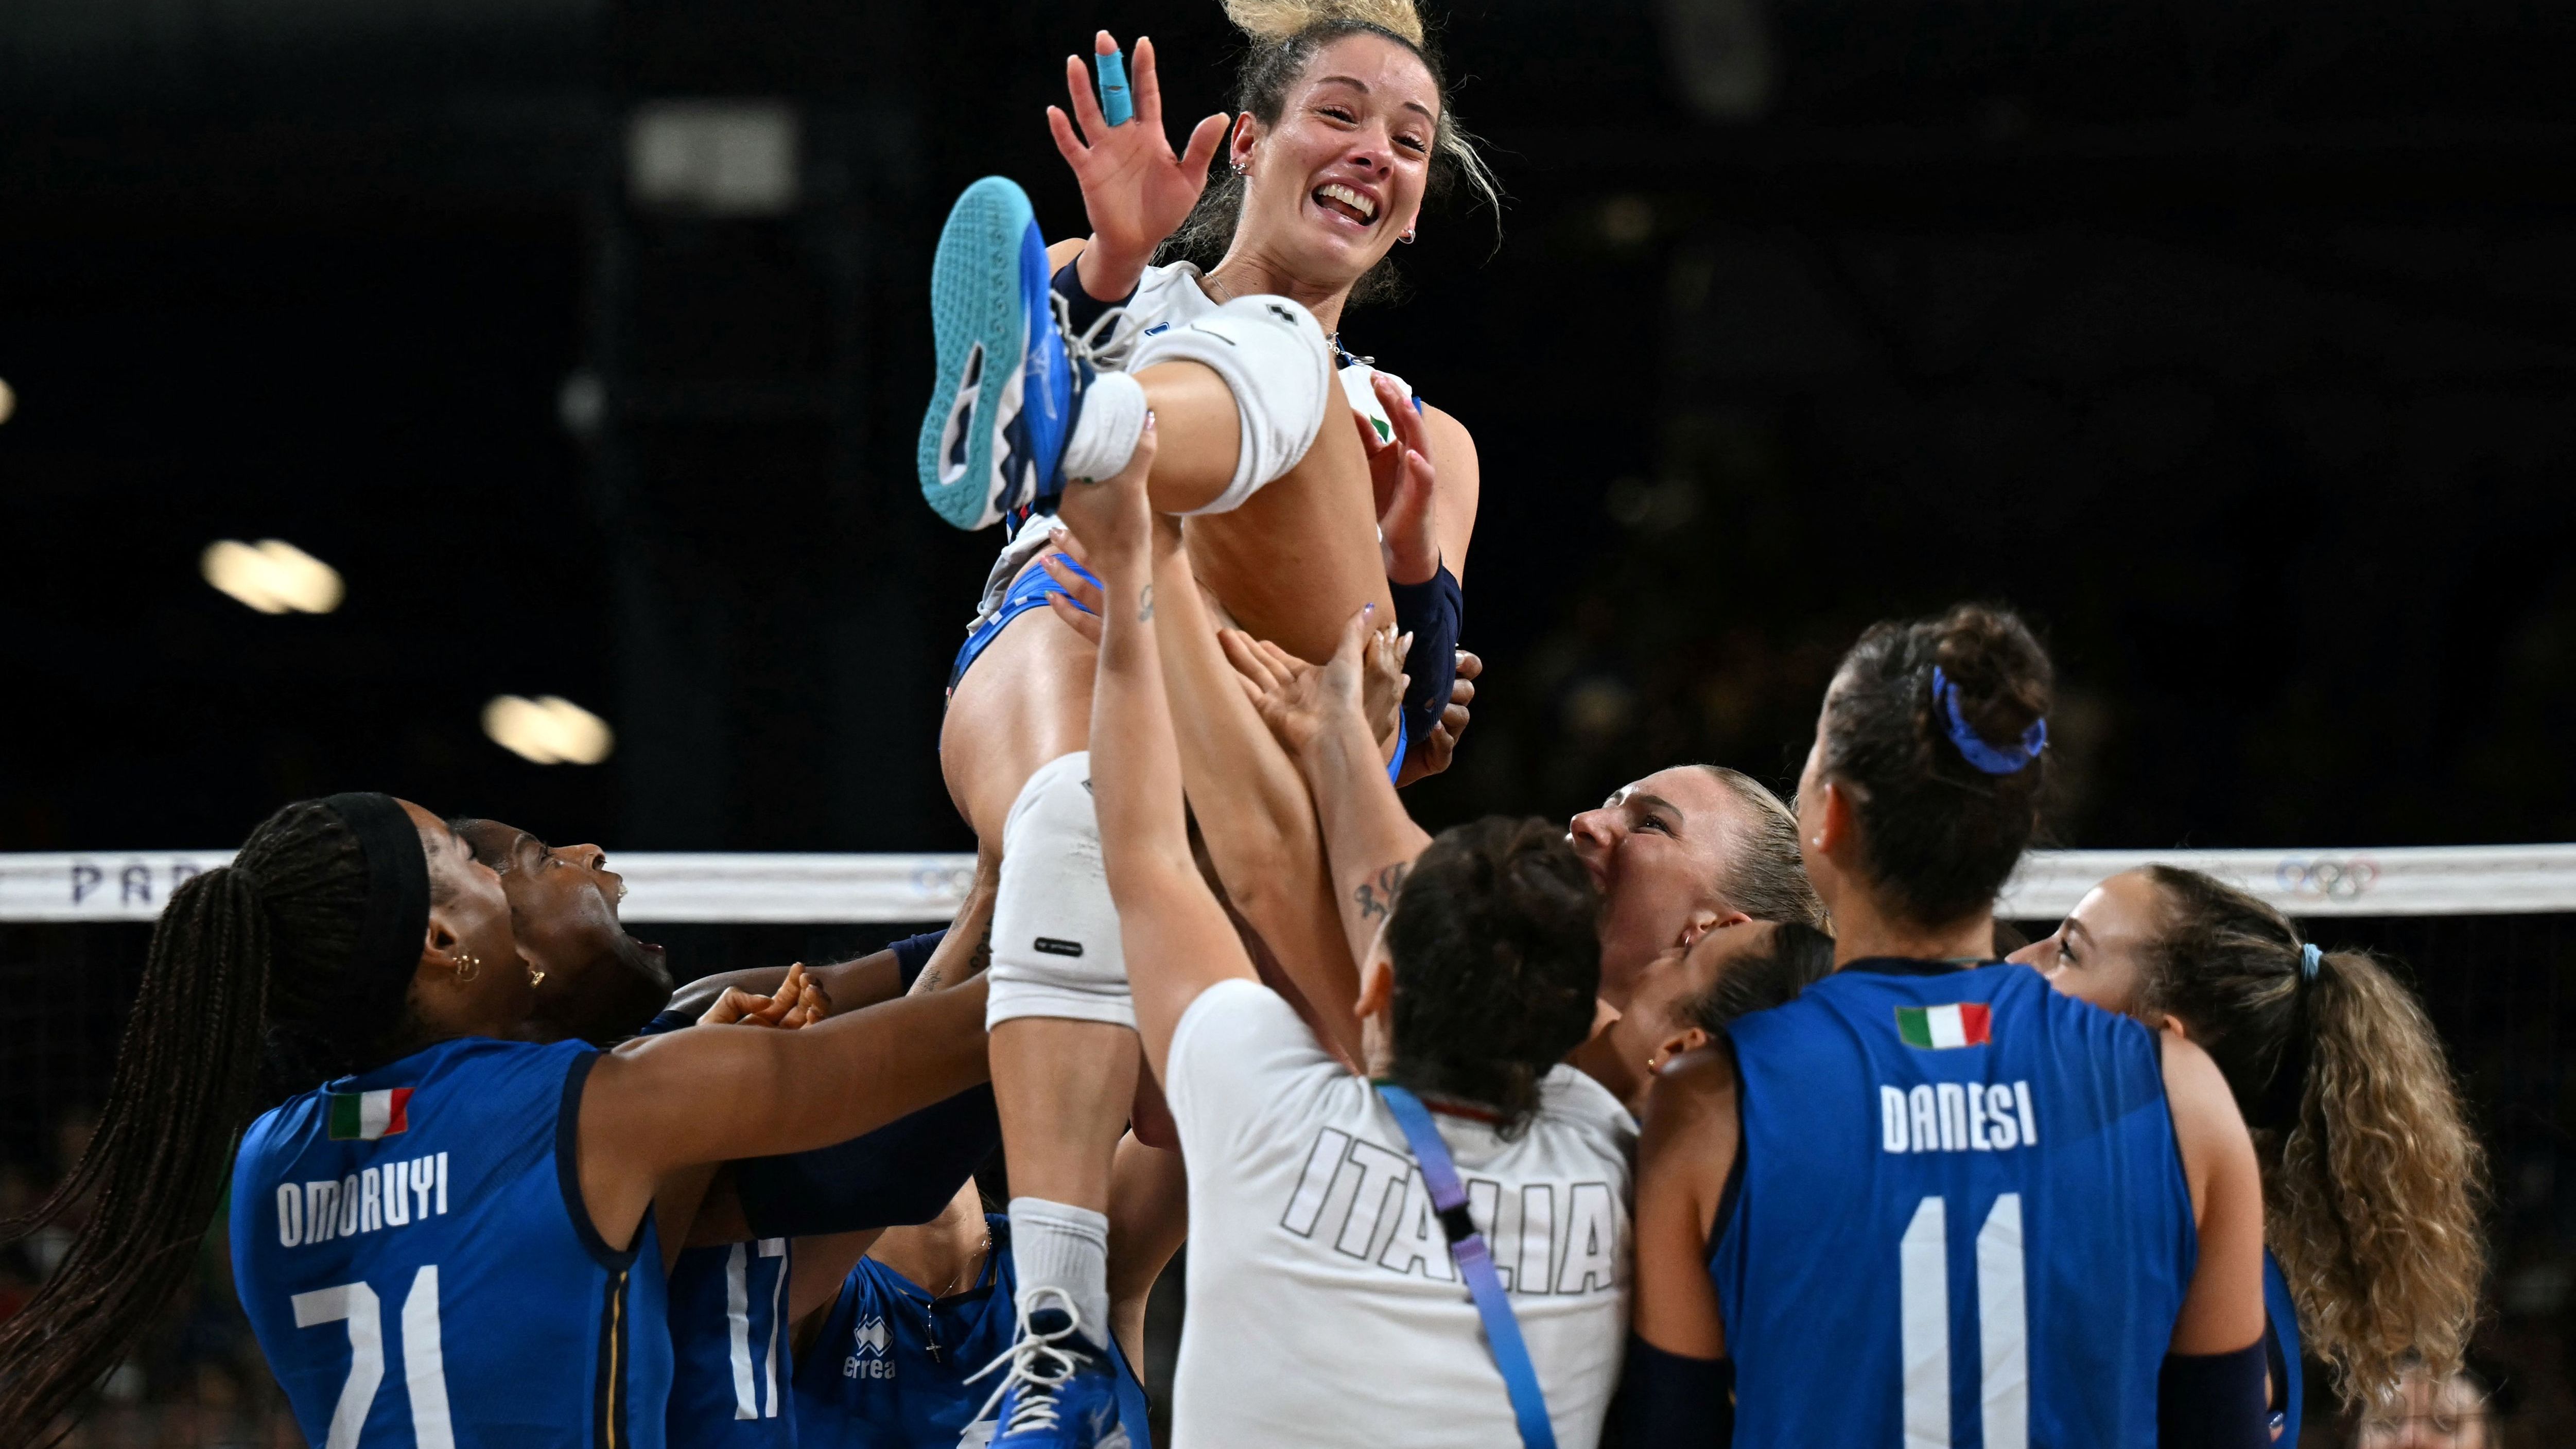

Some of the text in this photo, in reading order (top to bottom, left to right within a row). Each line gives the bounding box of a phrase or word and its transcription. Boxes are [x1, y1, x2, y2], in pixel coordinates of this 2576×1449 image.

[1880, 1081, 2037, 1153] DANESI
[276, 1151, 448, 1248] OMORUYI
[726, 1237, 788, 1420] 17
[1900, 1192, 2028, 1449] 11
